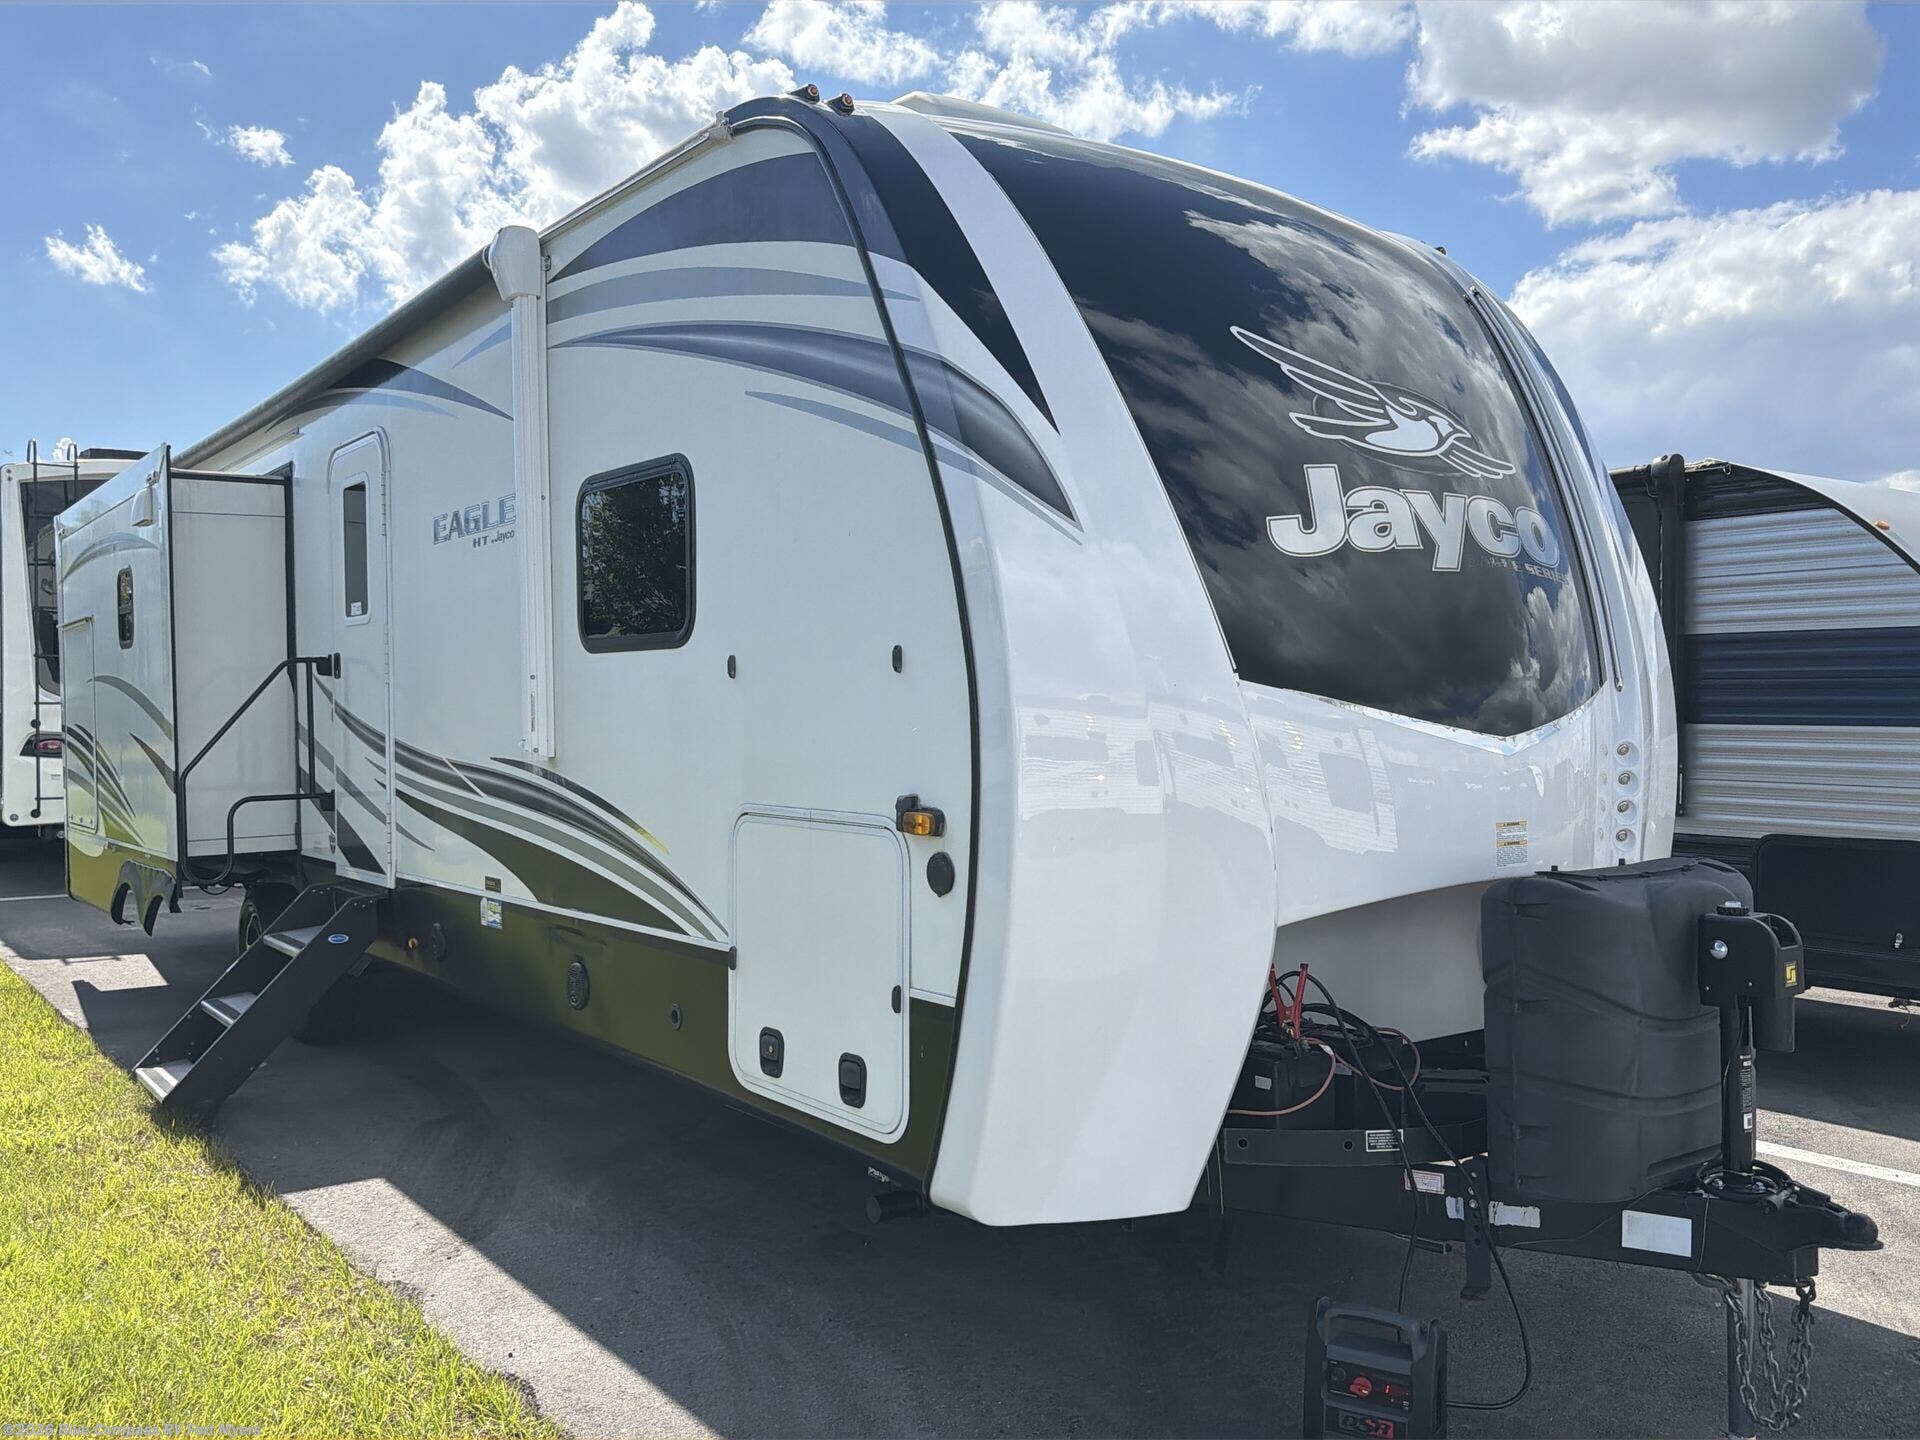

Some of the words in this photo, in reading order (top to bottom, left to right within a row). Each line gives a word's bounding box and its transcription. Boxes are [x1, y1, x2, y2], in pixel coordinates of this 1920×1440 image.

[432, 492, 516, 545] EAGLE
[472, 535, 489, 548] HT
[1265, 463, 1560, 572] Jayco
